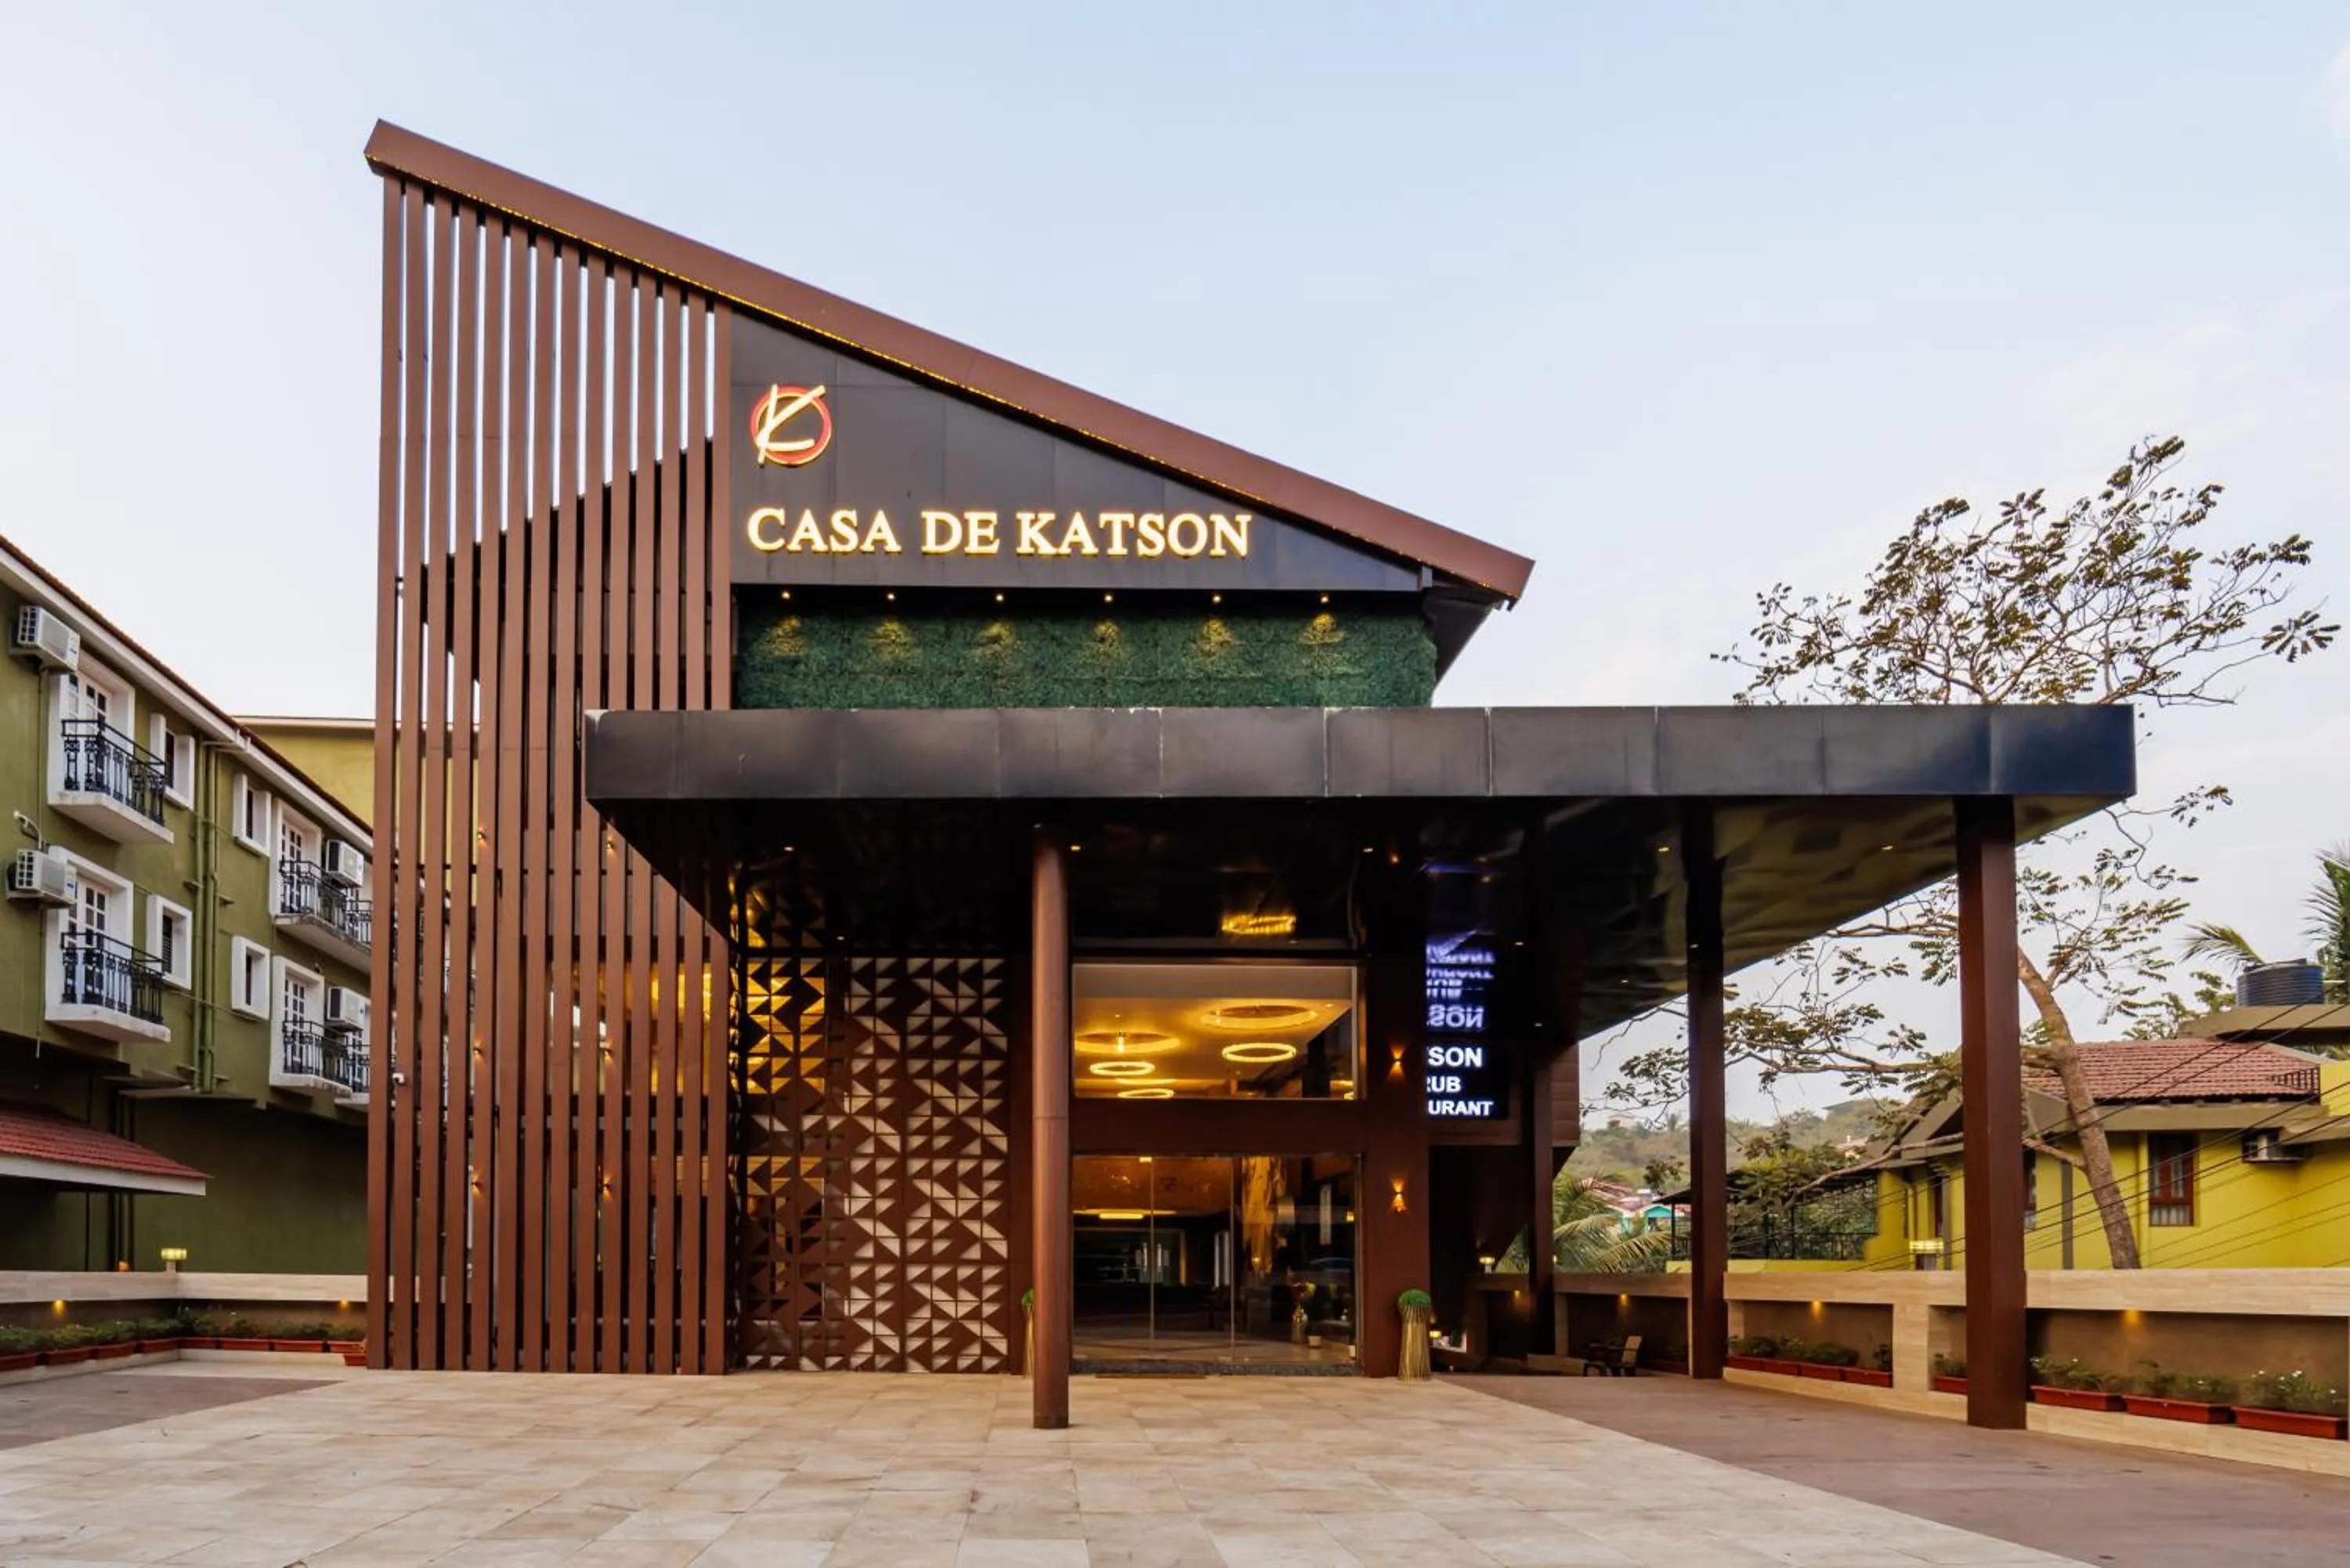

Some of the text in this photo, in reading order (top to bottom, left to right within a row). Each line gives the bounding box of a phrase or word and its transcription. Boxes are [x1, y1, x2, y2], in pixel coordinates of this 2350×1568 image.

[747, 508, 1252, 558] CASA DE KATSON
[1426, 1046, 1483, 1068] SON
[1428, 1100, 1494, 1116] URANT
